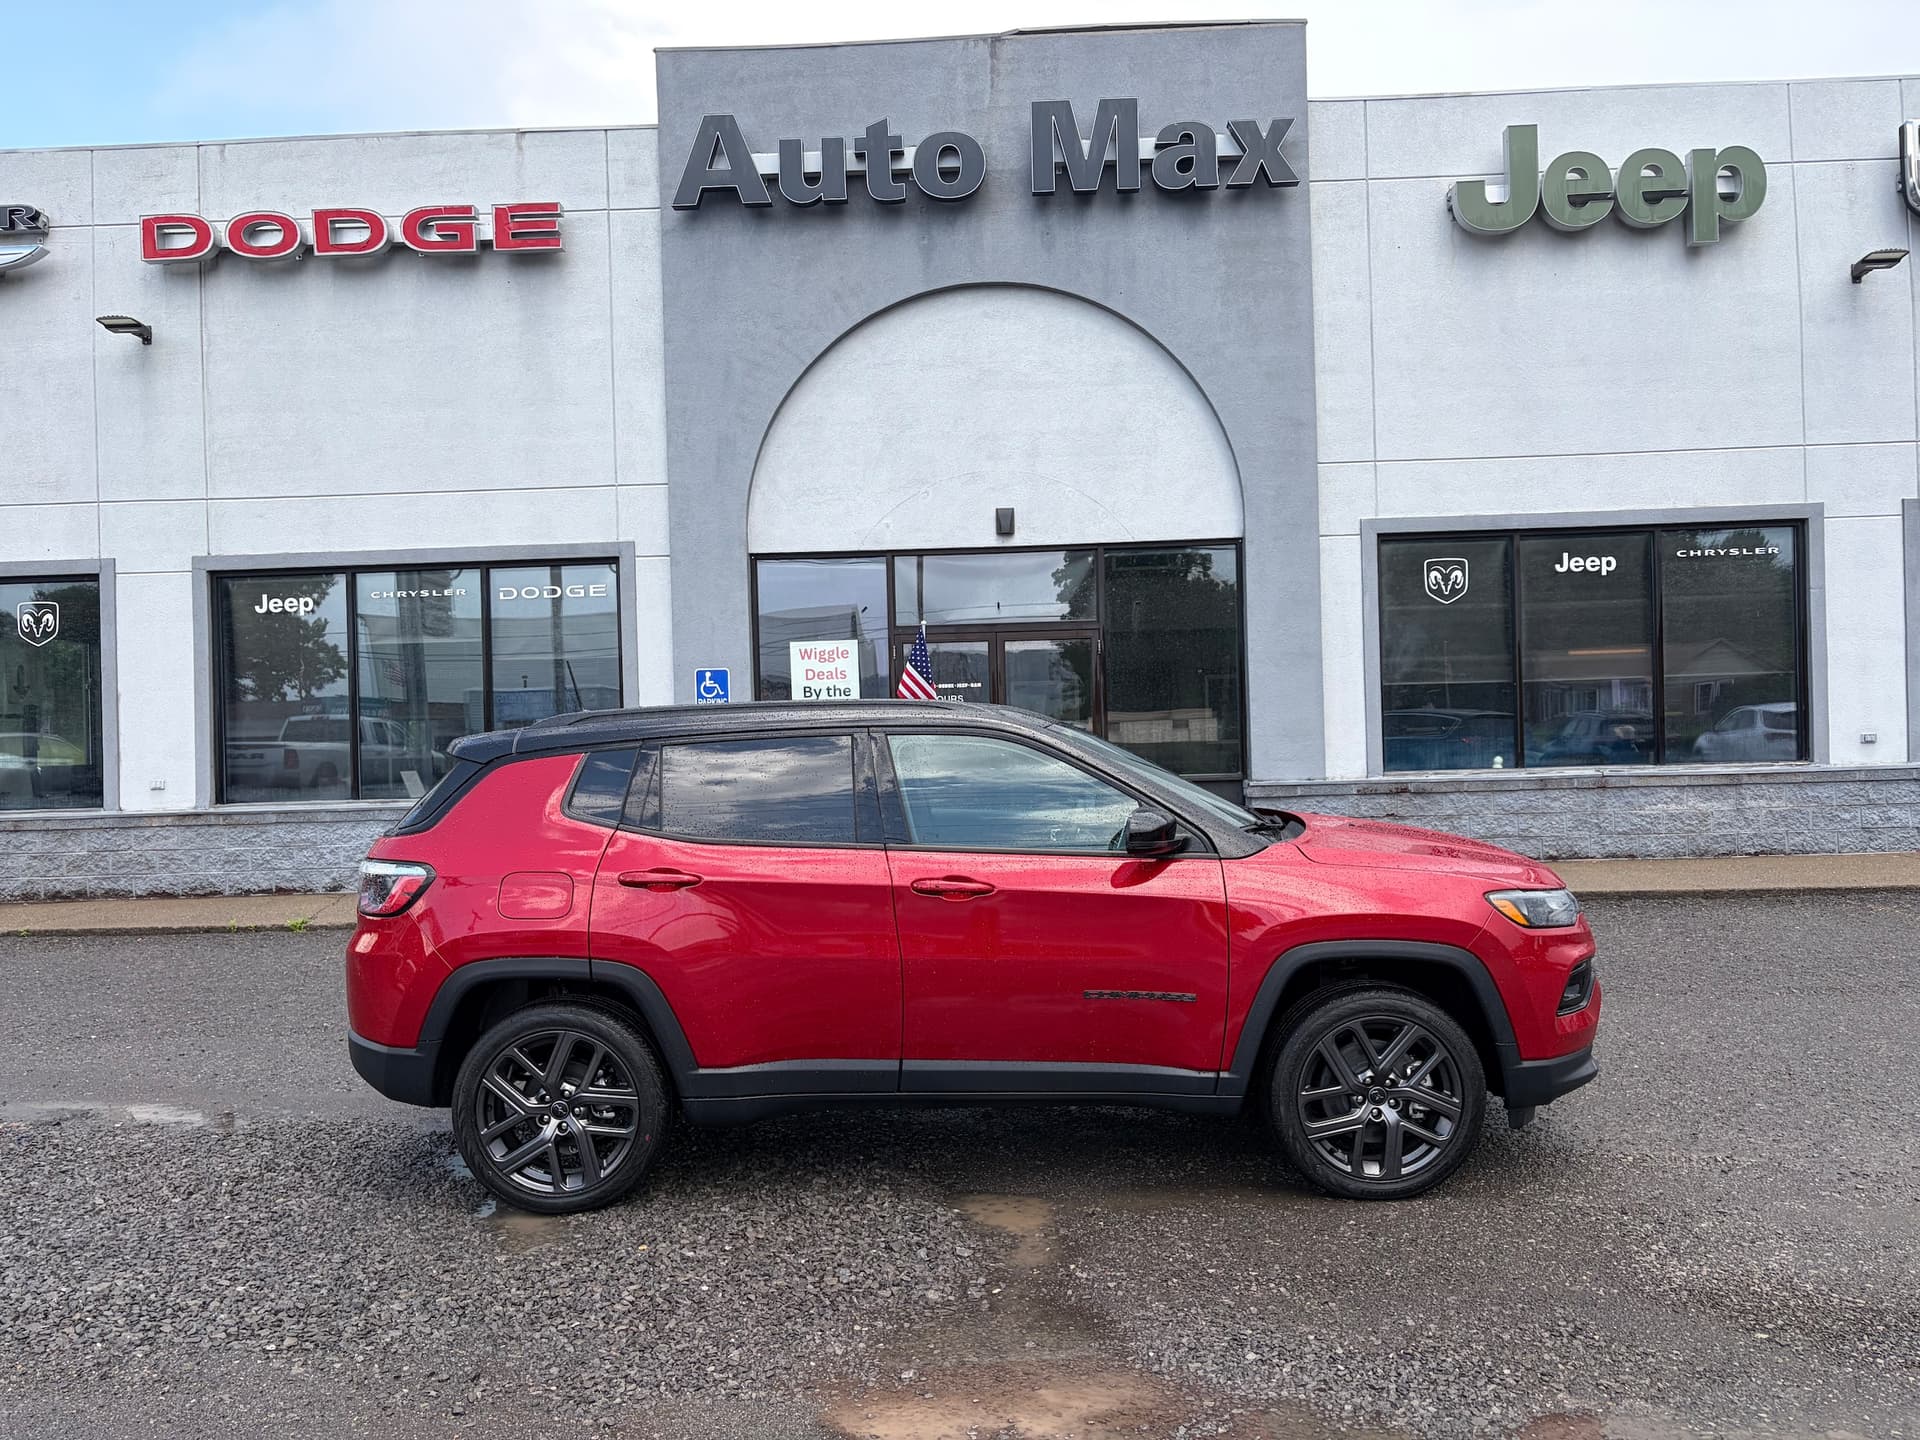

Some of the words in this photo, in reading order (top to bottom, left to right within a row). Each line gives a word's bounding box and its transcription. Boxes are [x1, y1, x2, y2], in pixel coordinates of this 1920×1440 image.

[672, 113, 987, 210] Auto
[1031, 97, 1300, 197] Max
[1451, 124, 1767, 247] Jeep
[139, 202, 566, 264] DODGE
[1676, 546, 1780, 558] CHRYSLER
[1555, 552, 1617, 576] Jeep
[370, 587, 467, 599] CHRYSLER
[499, 583, 607, 601] DODGE
[254, 593, 314, 616] Jeep
[799, 646, 849, 663] Wiggle
[805, 667, 847, 681] Deals
[803, 686, 822, 700] By
[826, 684, 852, 698] the
